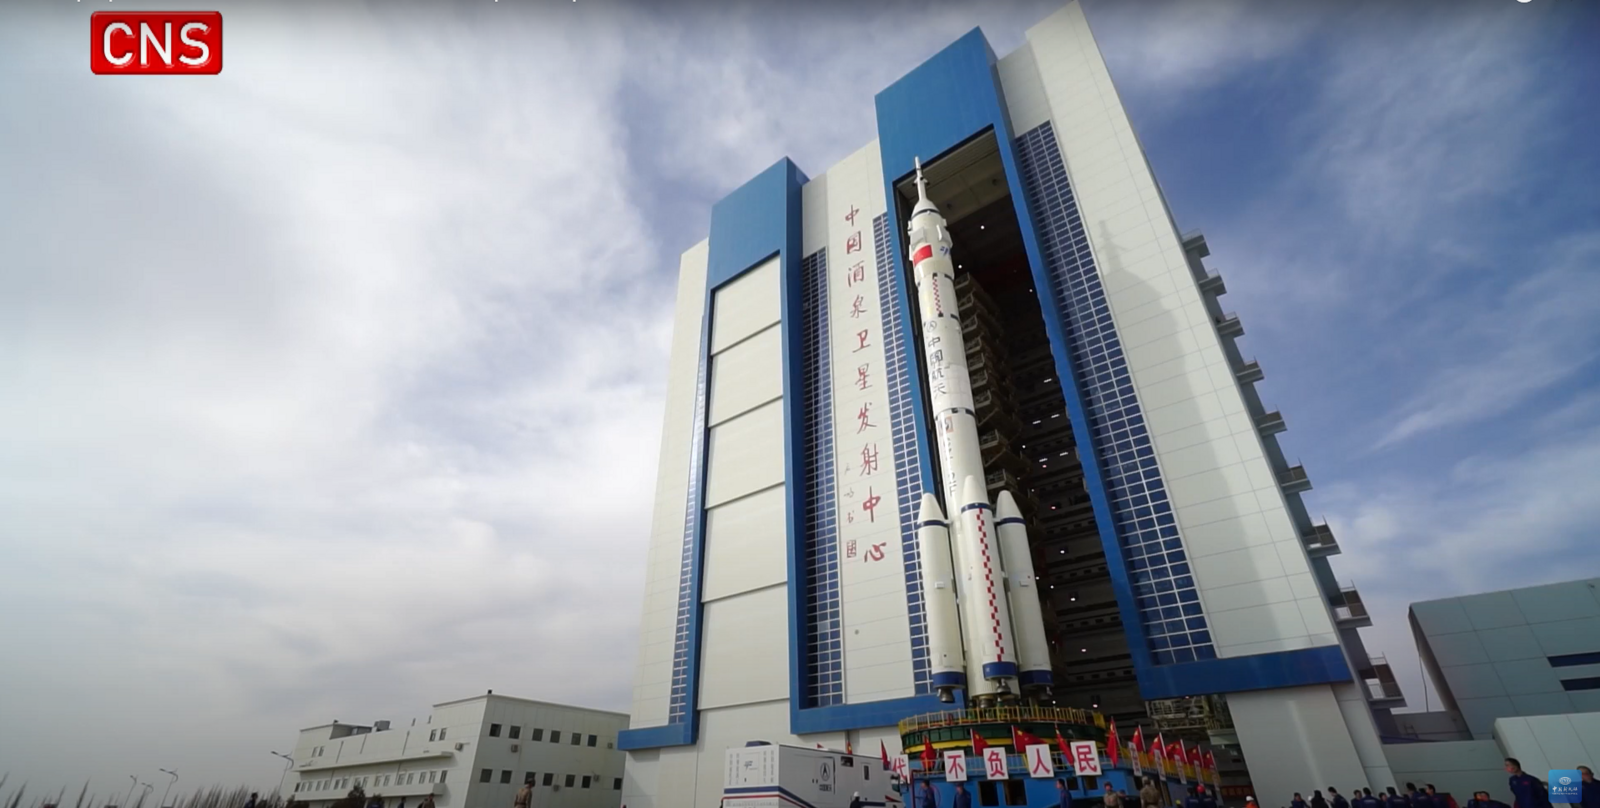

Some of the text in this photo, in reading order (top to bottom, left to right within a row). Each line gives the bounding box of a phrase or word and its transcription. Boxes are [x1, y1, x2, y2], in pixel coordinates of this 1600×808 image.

[844, 204, 887, 563] 中国酒泉卫星发射中心
[947, 745, 1098, 779] 不负人民
